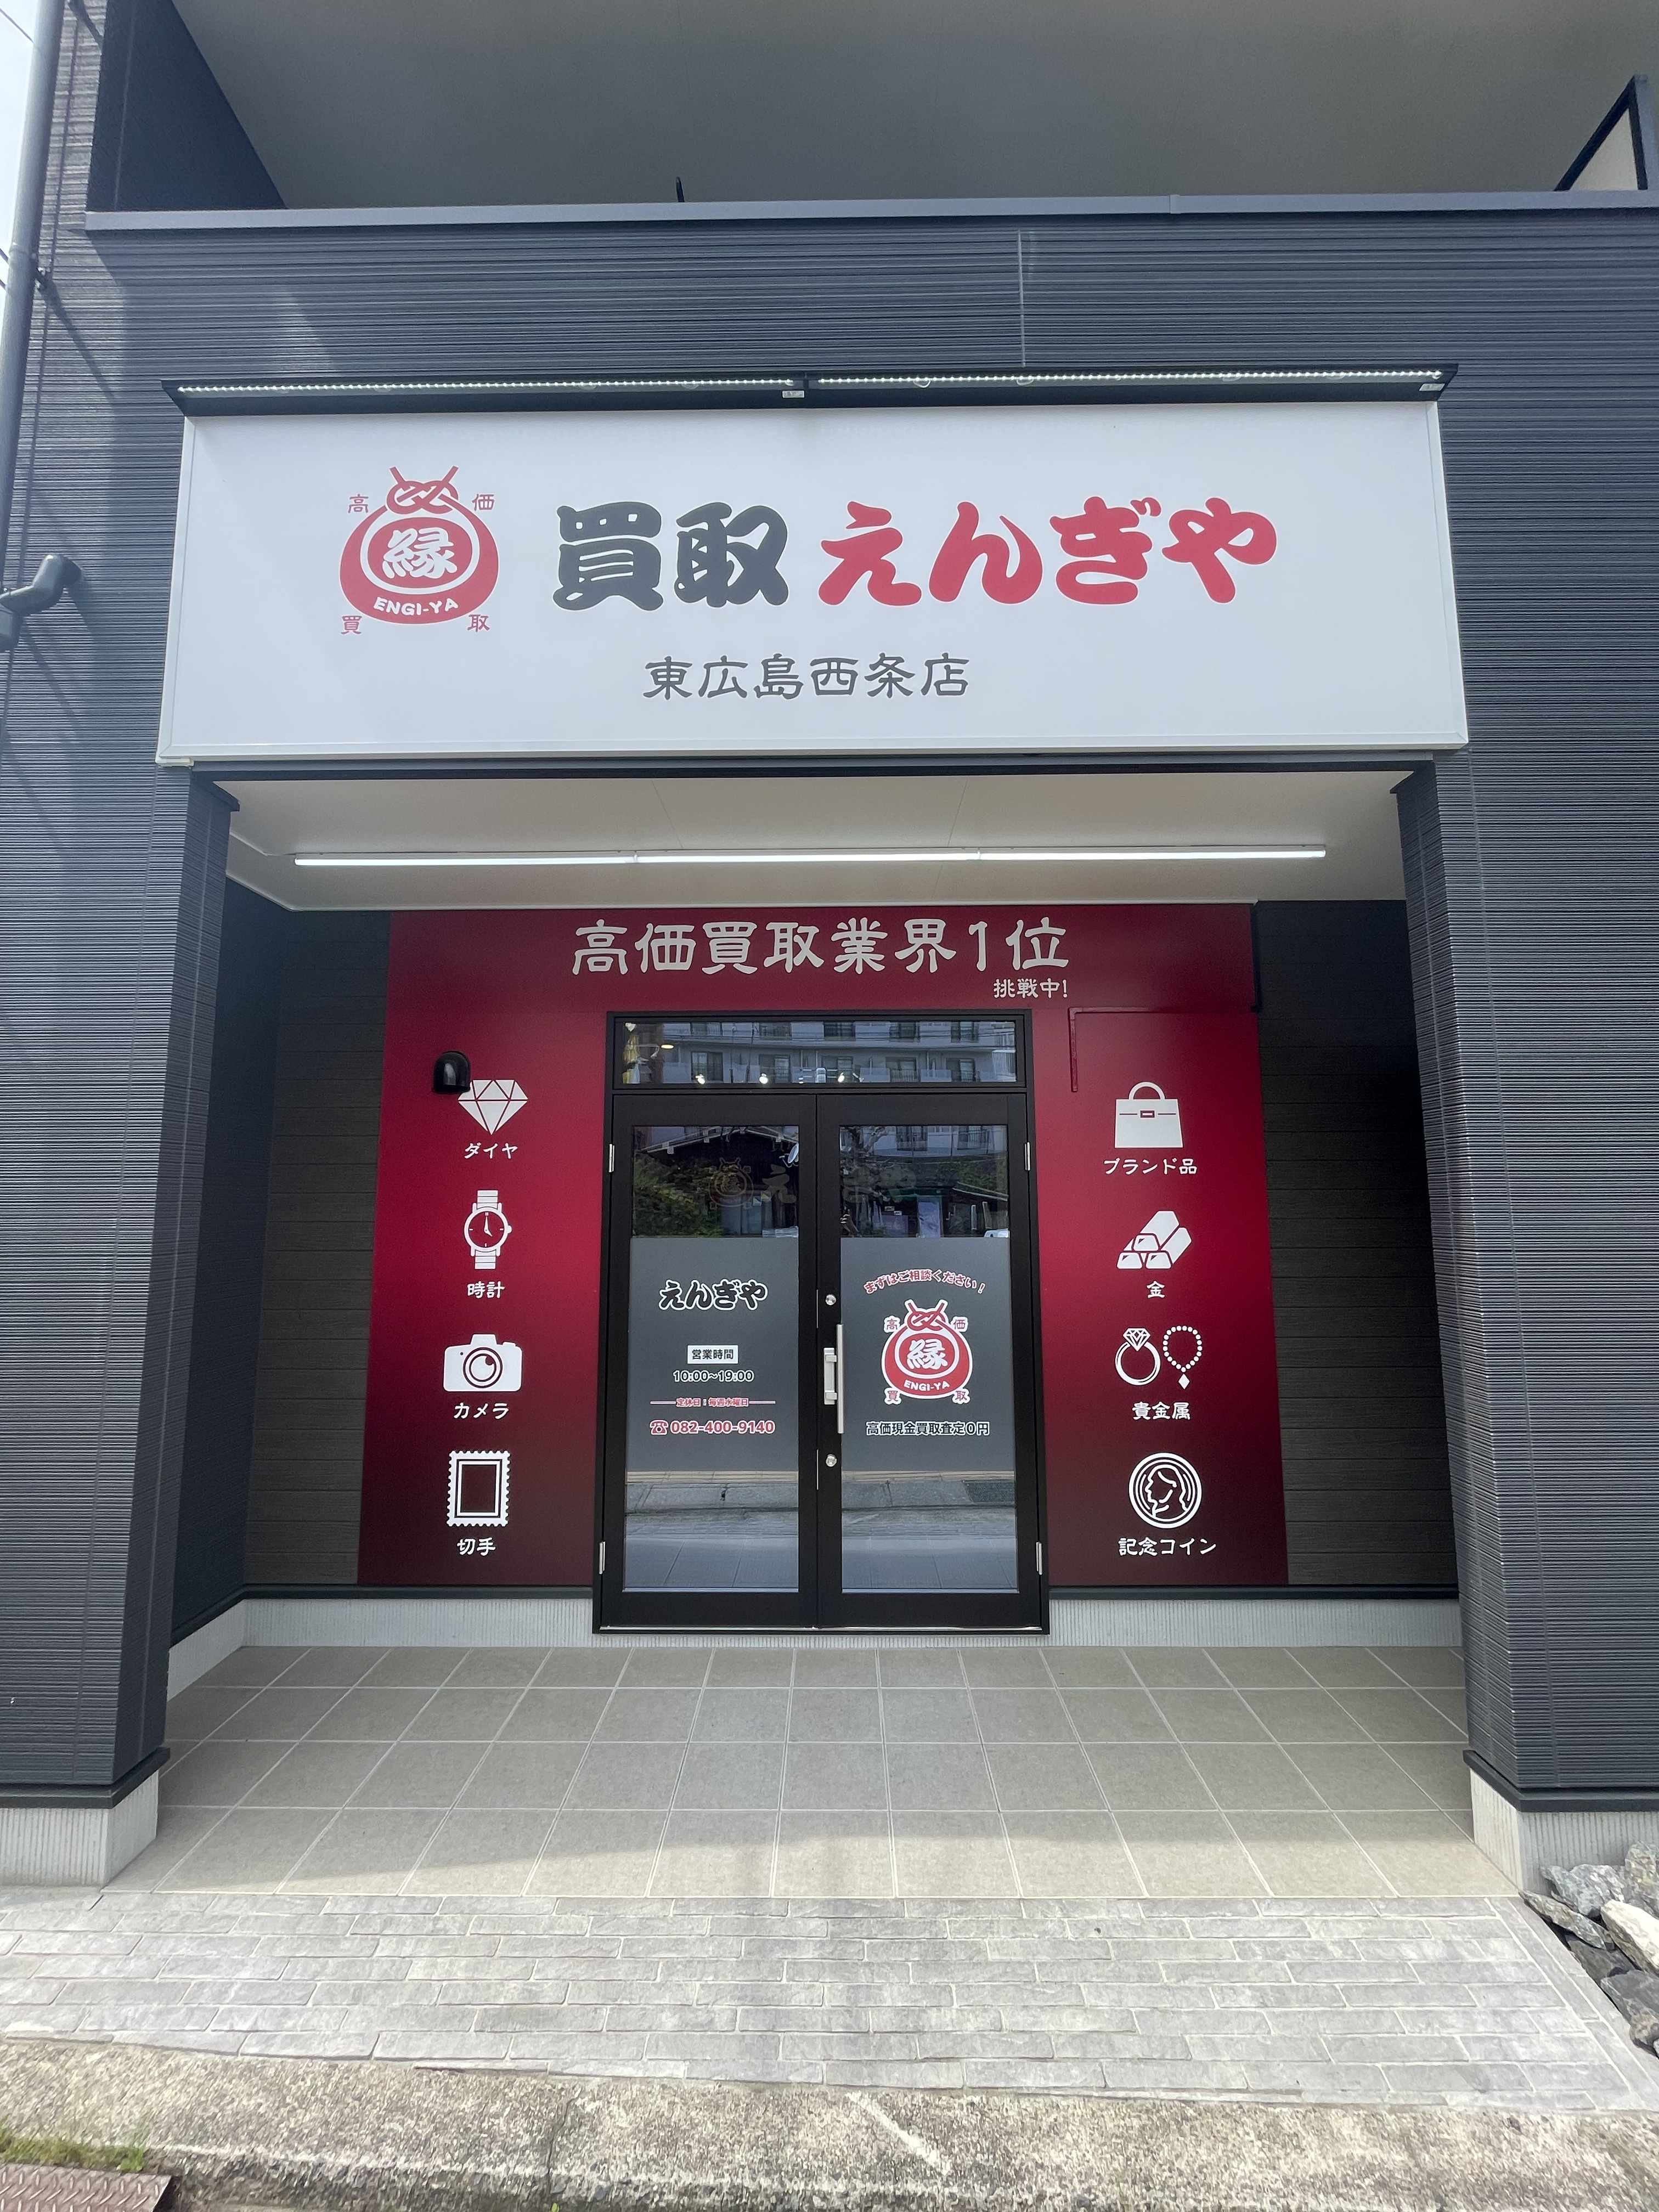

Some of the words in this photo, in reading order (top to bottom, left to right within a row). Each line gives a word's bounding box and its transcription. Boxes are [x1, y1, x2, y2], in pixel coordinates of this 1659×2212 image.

[347, 494, 369, 514] 高
[472, 493, 495, 511] 価
[381, 528, 458, 579] 縁
[553, 501, 789, 611] 買取
[818, 496, 1277, 606] えんぎや
[373, 596, 459, 616] ENGI-YA
[340, 614, 363, 635] 買
[467, 614, 490, 633] 取
[642, 653, 969, 700] 東広島西条店
[572, 916, 1069, 975] 高価買取業界1位
[992, 978, 1068, 999] 挑戦中!
[464, 1142, 518, 1159] ダイヤ
[1103, 1157, 1198, 1175] ブランド品
[466, 1280, 505, 1299] 時計
[658, 1278, 768, 1311] えんぎや
[1146, 1280, 1165, 1299] 金
[885, 1317, 899, 1331] 高
[952, 1317, 967, 1331] 価
[691, 1348, 734, 1361] 営業時間
[906, 1338, 948, 1370] 縁
[904, 1380, 950, 1392] ENGI-YA
[885, 1389, 900, 1403] 買
[954, 1389, 969, 1403] 取
[453, 1402, 509, 1419] カメラ
[1132, 1401, 1191, 1420] 貴金属
[670, 1420, 775, 1435] 082-400-9140
[456, 1537, 496, 1556] 切手
[1118, 1537, 1217, 1556] 記念コイン
